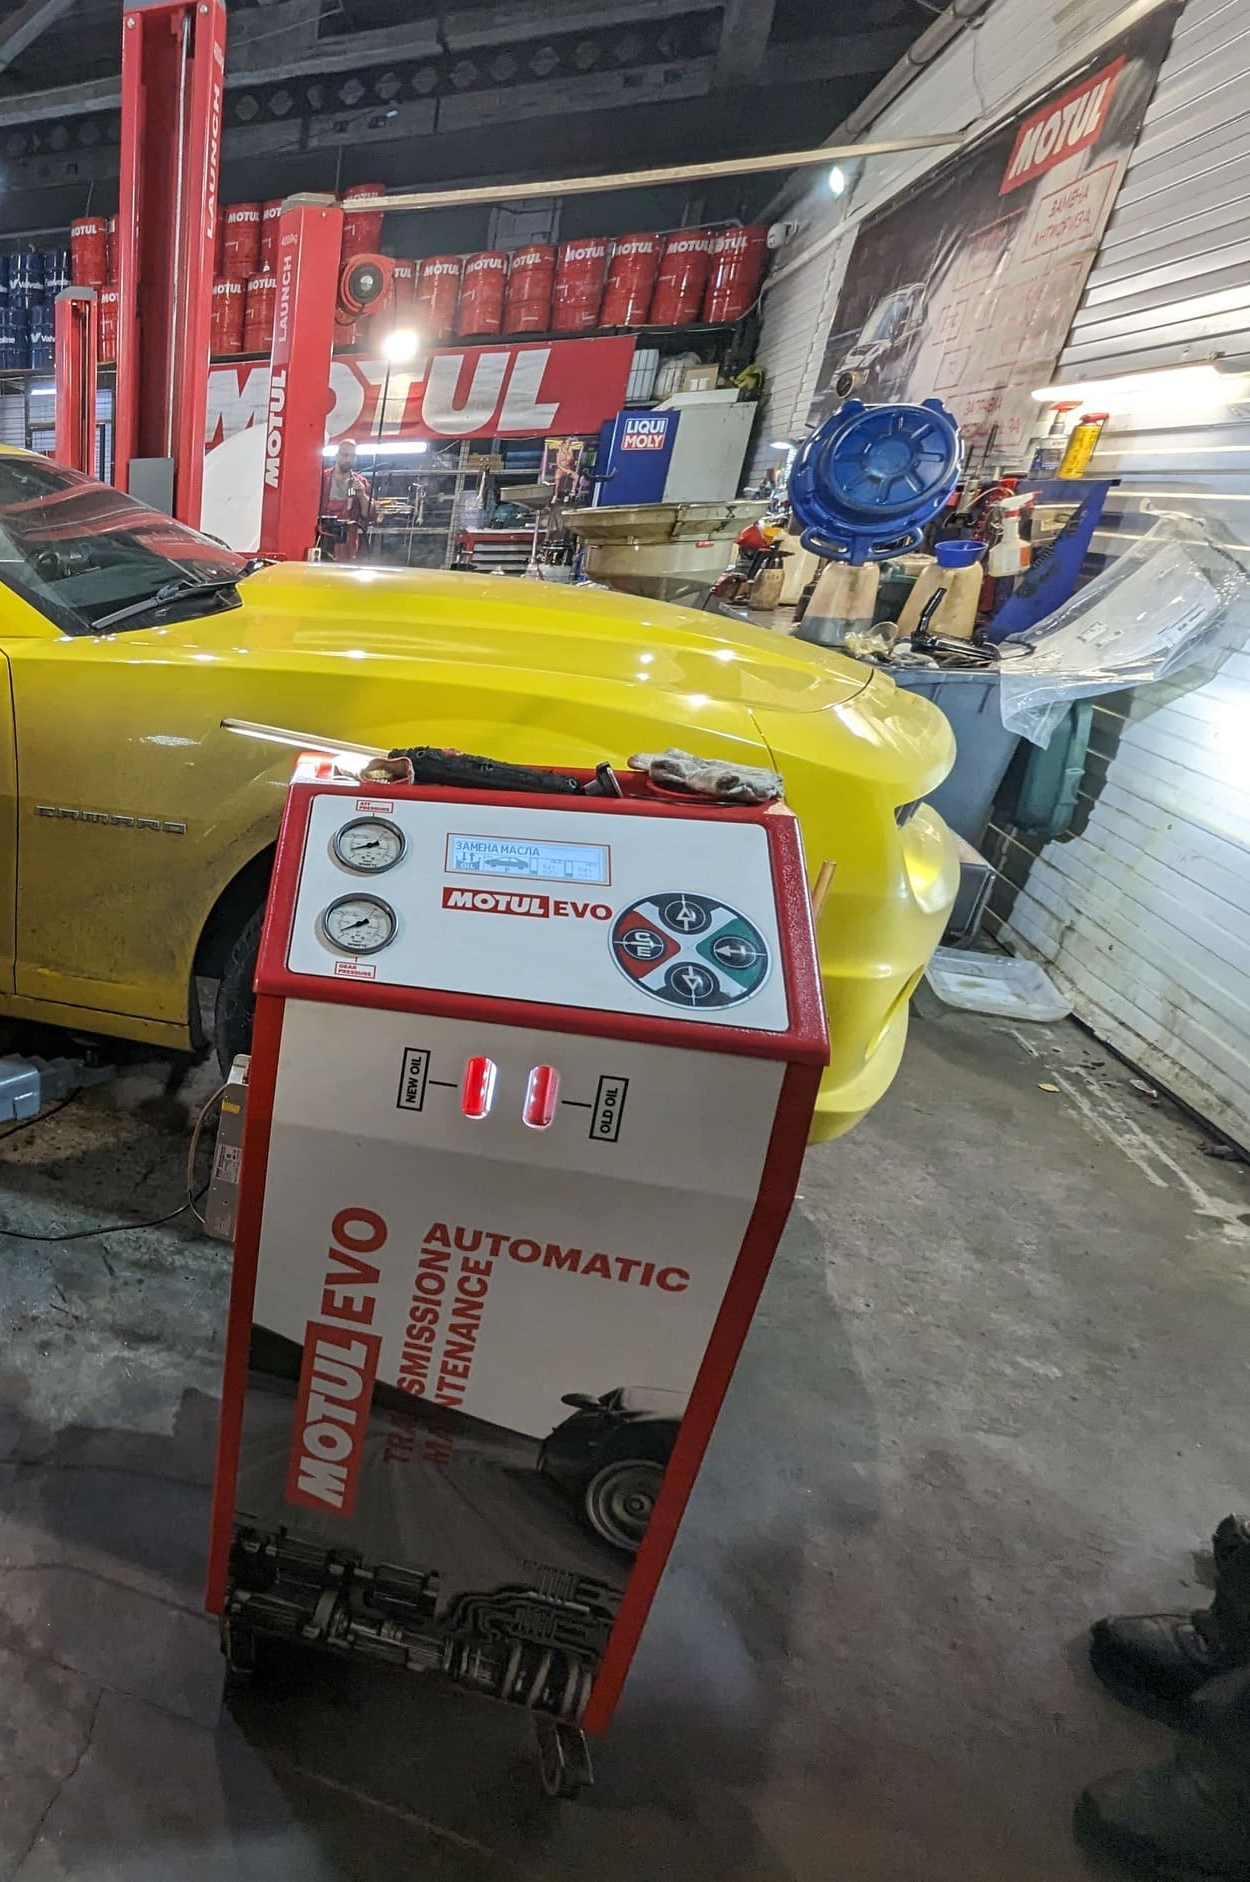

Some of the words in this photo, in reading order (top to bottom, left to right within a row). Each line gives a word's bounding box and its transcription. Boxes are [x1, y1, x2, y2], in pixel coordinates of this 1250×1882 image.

[1007, 77, 1111, 181] MOTUL
[206, 84, 221, 239] LAUNCH
[228, 211, 260, 223] MOTUL
[263, 207, 282, 220] MOT
[512, 253, 542, 268] OTUL
[565, 245, 605, 262] MOTUL
[394, 267, 412, 278] TUL
[423, 263, 460, 277] MOTUL
[466, 258, 503, 274] MOTUL
[278, 255, 293, 342] LAUNCH
[265, 370, 287, 488] MOTUL
[627, 420, 665, 434] LIQUI
[623, 434, 664, 448] MOLY
[456, 841, 498, 854] ЗАМЕНА
[501, 845, 540, 857] МАСЛА
[460, 862, 476, 870] OIL
[447, 890, 545, 915] MOTUL
[553, 900, 613, 921] EVO
[410, 1056, 422, 1076] OIL
[405, 1078, 418, 1103] NEW
[604, 1087, 619, 1107] OIL
[600, 1107, 613, 1134] OLD
[320, 1206, 389, 1326] EVO
[422, 1222, 691, 1293] AUTOMATIC
[383, 1247, 451, 1464] TRASMISSION
[422, 1256, 494, 1465] MANTENANCE
[296, 1338, 369, 1509] MOTUL
